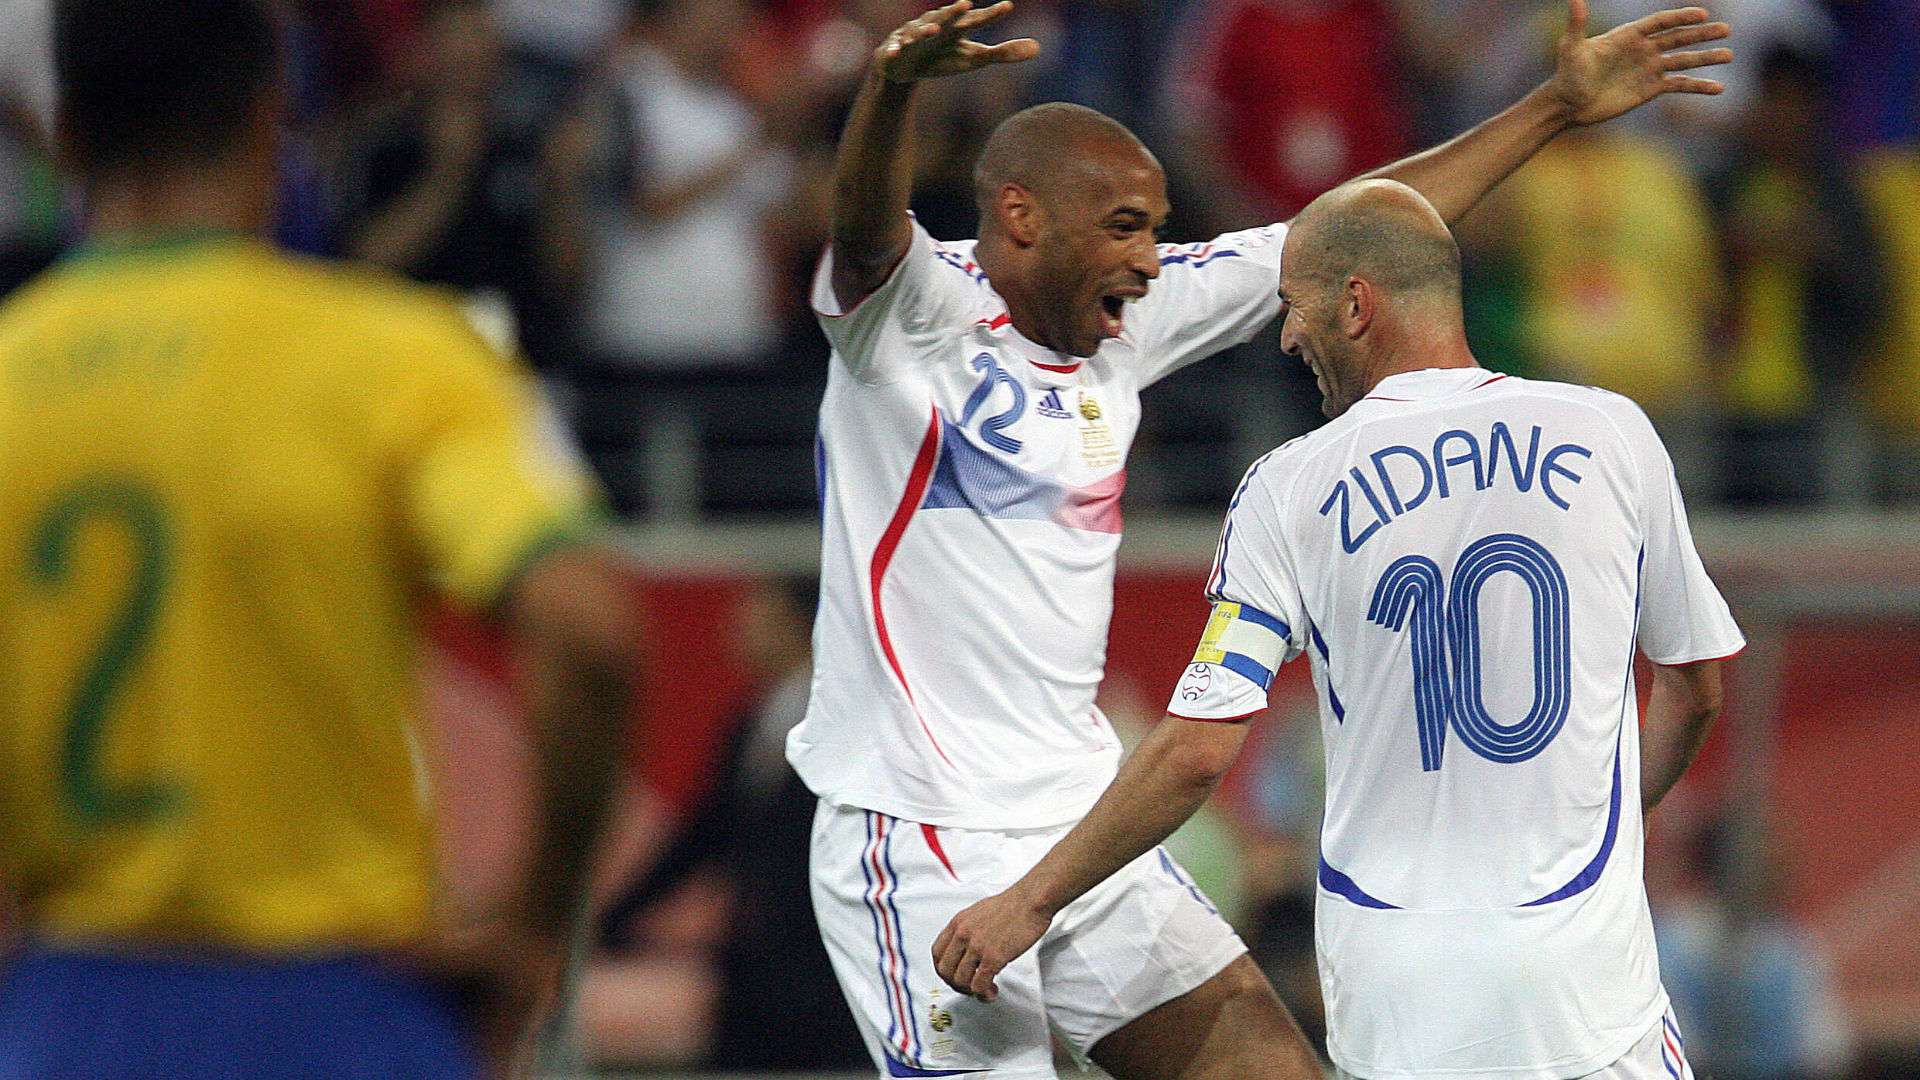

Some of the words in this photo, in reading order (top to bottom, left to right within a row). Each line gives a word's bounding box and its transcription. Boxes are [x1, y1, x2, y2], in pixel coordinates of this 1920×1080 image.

[960, 351, 1026, 454] 12
[1319, 421, 1592, 554] ZIDANE
[27, 475, 190, 824] 2
[1366, 533, 1571, 772] 10
